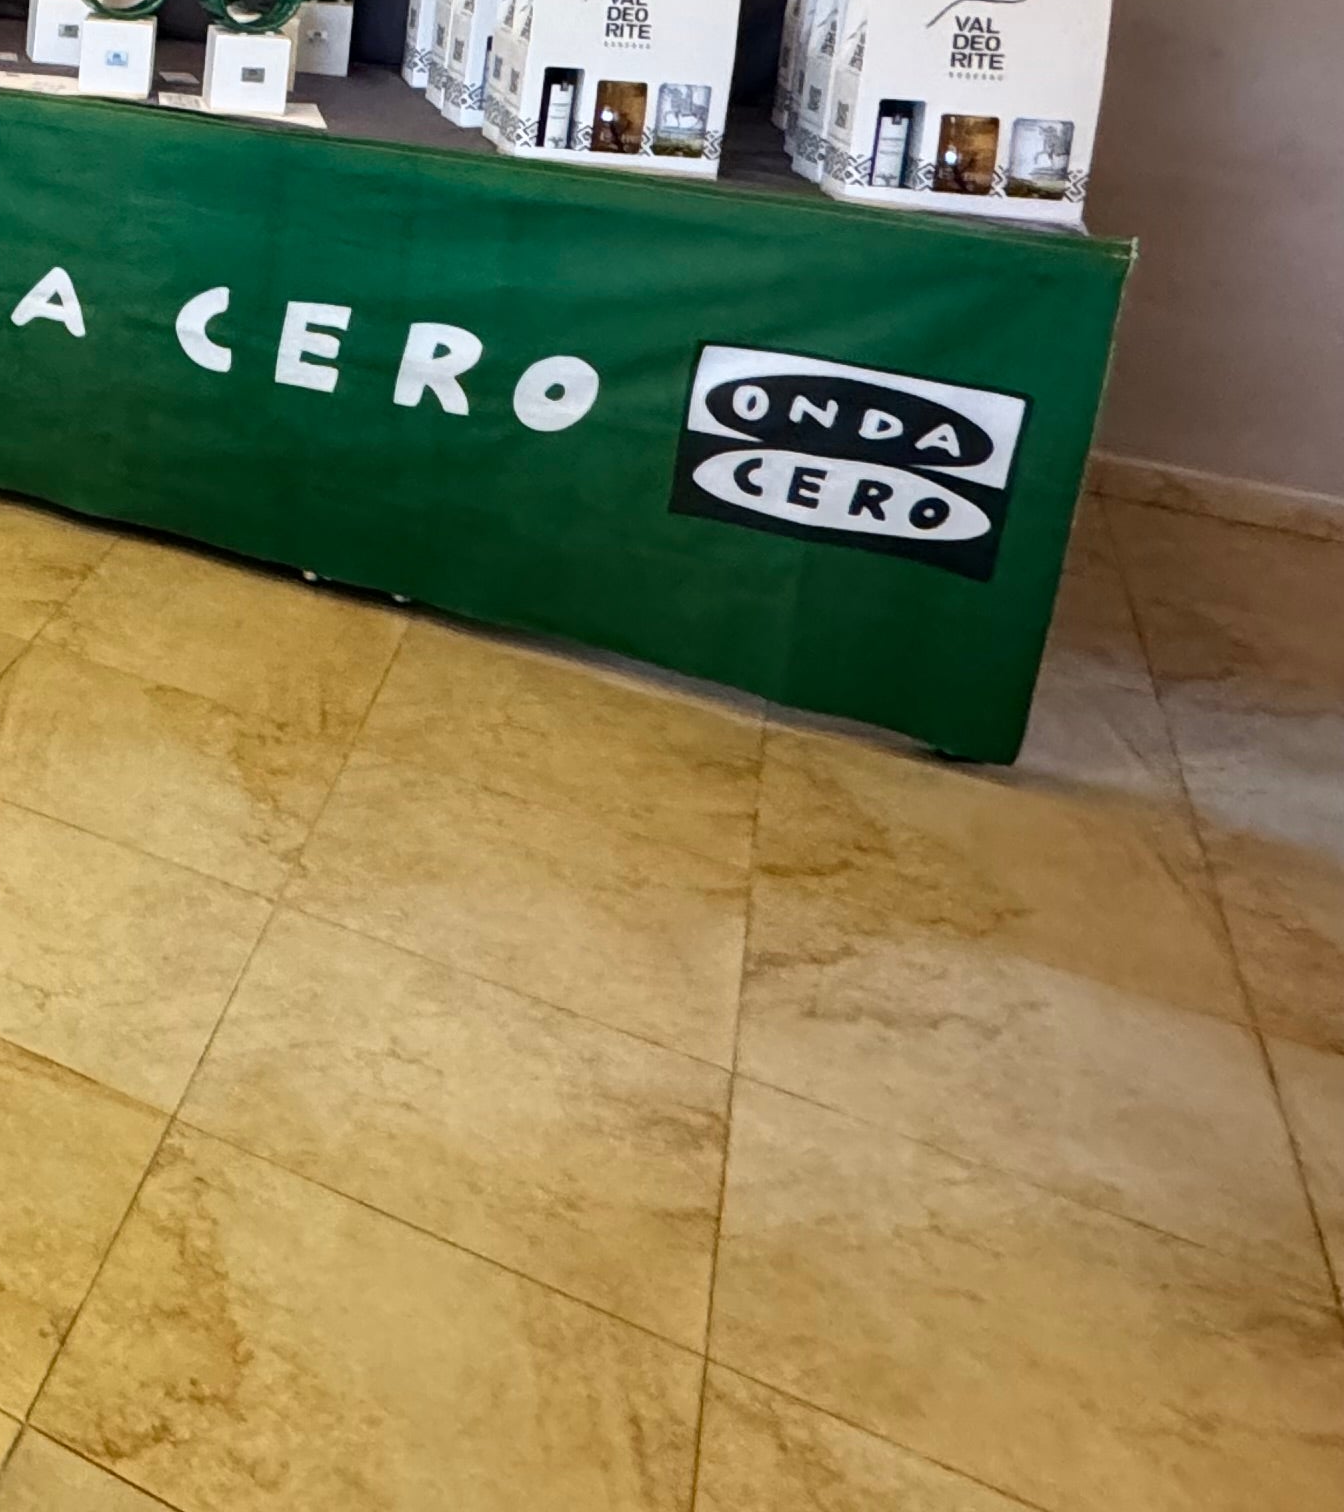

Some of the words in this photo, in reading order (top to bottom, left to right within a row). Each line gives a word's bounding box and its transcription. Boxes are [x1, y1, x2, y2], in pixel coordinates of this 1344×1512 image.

[607, 6, 649, 23] DEO
[605, 22, 652, 40] RITE
[955, 15, 1001, 34] VAL
[952, 33, 1001, 52] DEO
[950, 51, 1005, 70] RITE
[174, 285, 600, 432] CERO
[731, 384, 964, 460] ONDA
[733, 455, 951, 531] CERO
